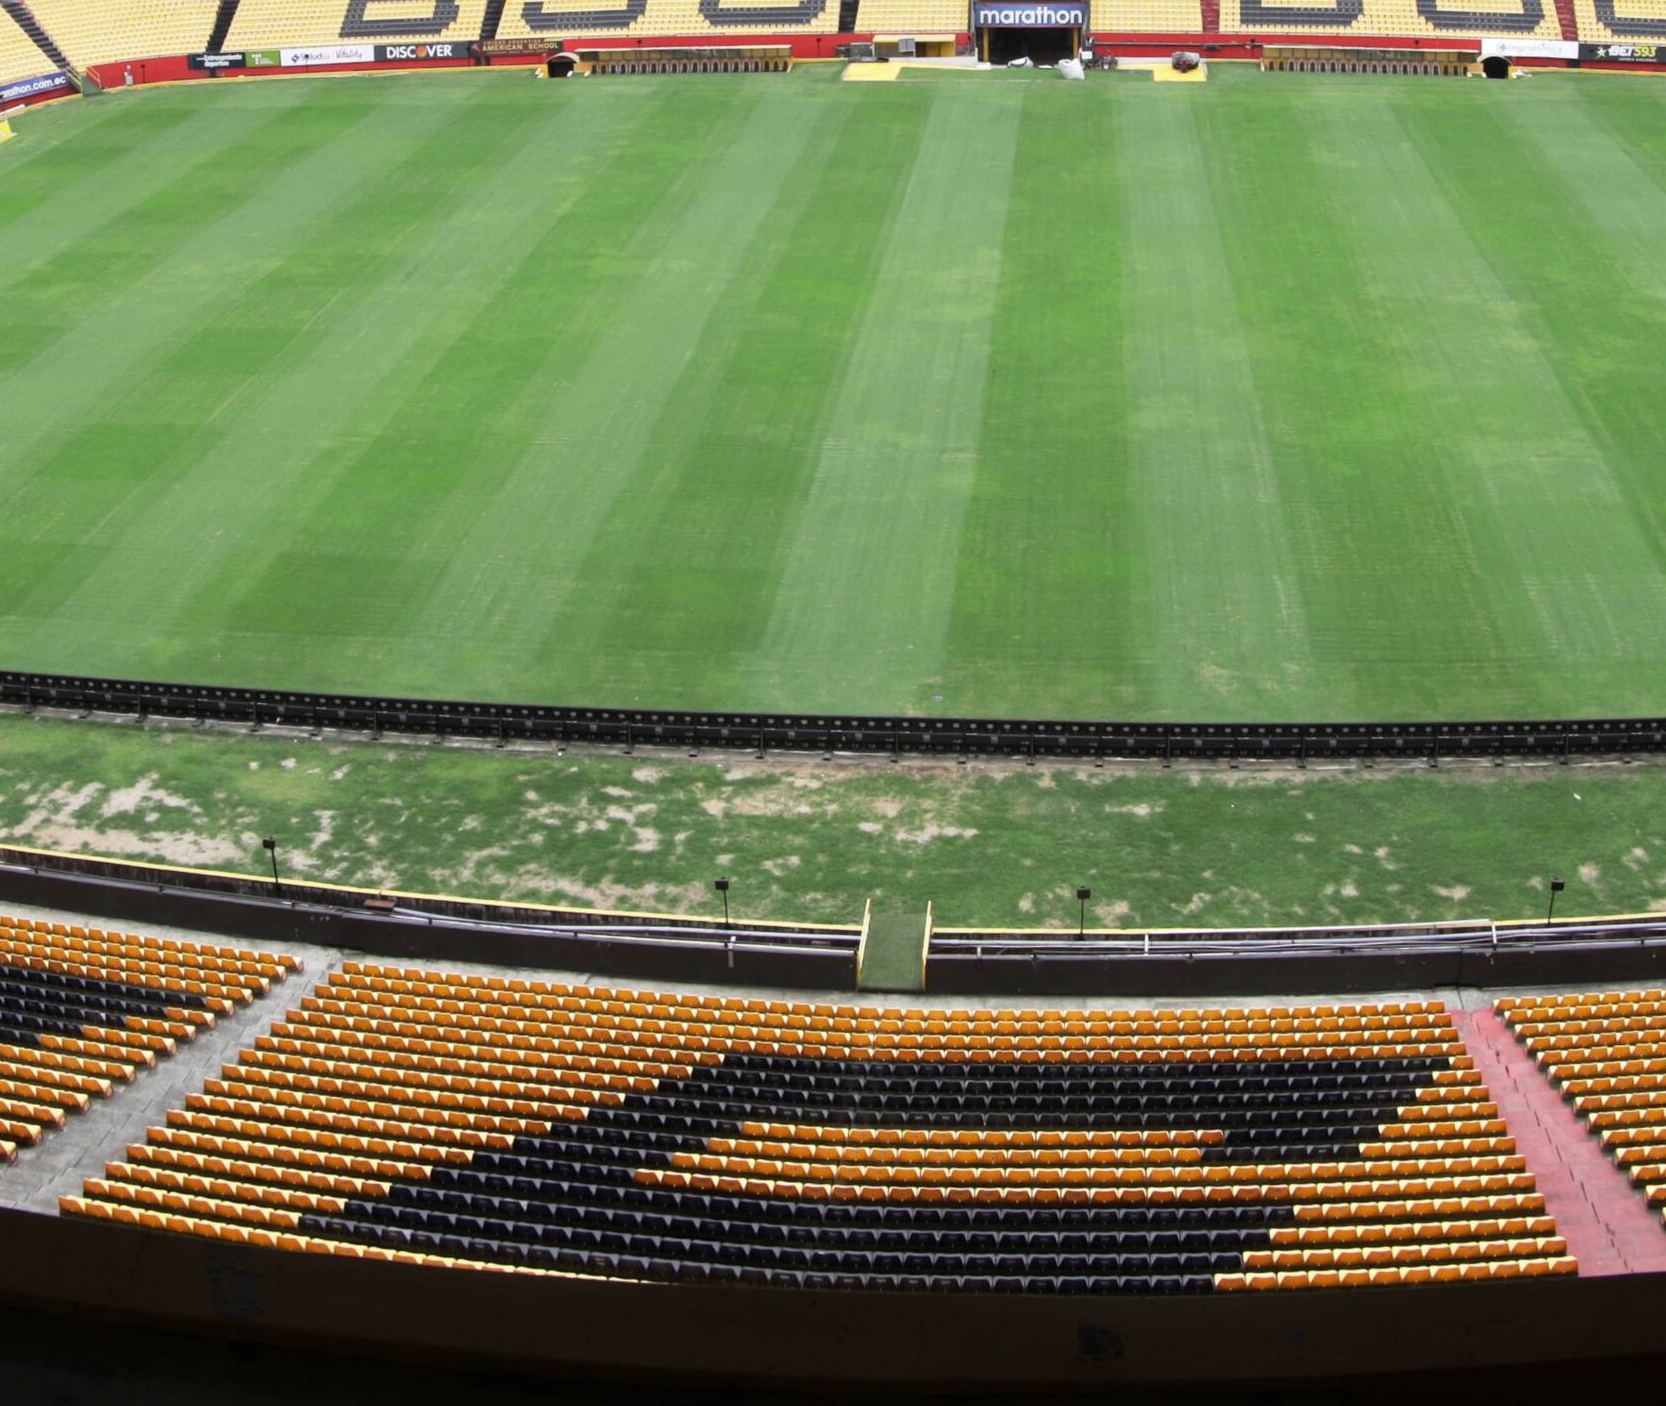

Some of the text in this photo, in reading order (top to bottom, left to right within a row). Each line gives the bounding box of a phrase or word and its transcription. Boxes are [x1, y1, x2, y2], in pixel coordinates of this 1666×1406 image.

[979, 6, 1083, 25] marathon
[386, 44, 453, 59] DISCOVER
[528, 42, 559, 50] SCHOOL
[1608, 45, 1657, 58] BET593
